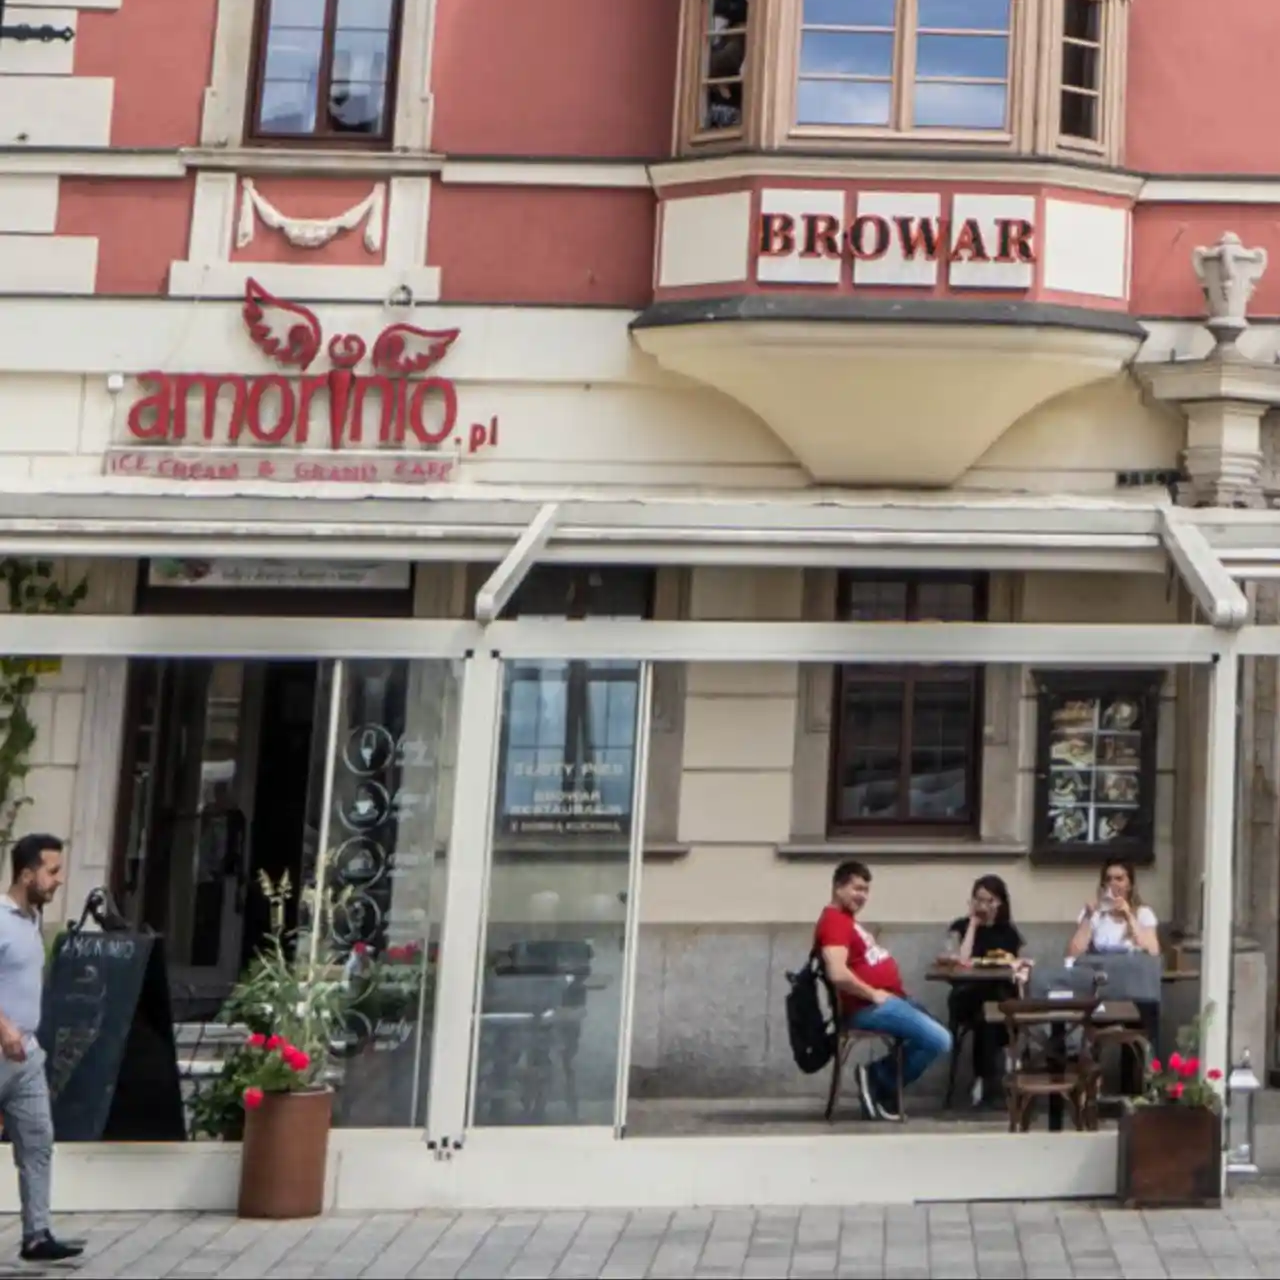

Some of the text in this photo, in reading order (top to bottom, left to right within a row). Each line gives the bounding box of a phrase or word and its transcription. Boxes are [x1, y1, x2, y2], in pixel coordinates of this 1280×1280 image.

[757, 212, 1037, 263] BROWAR
[110, 454, 149, 474] ICE
[157, 458, 240, 480] CREAM
[294, 460, 377, 482] GRAND
